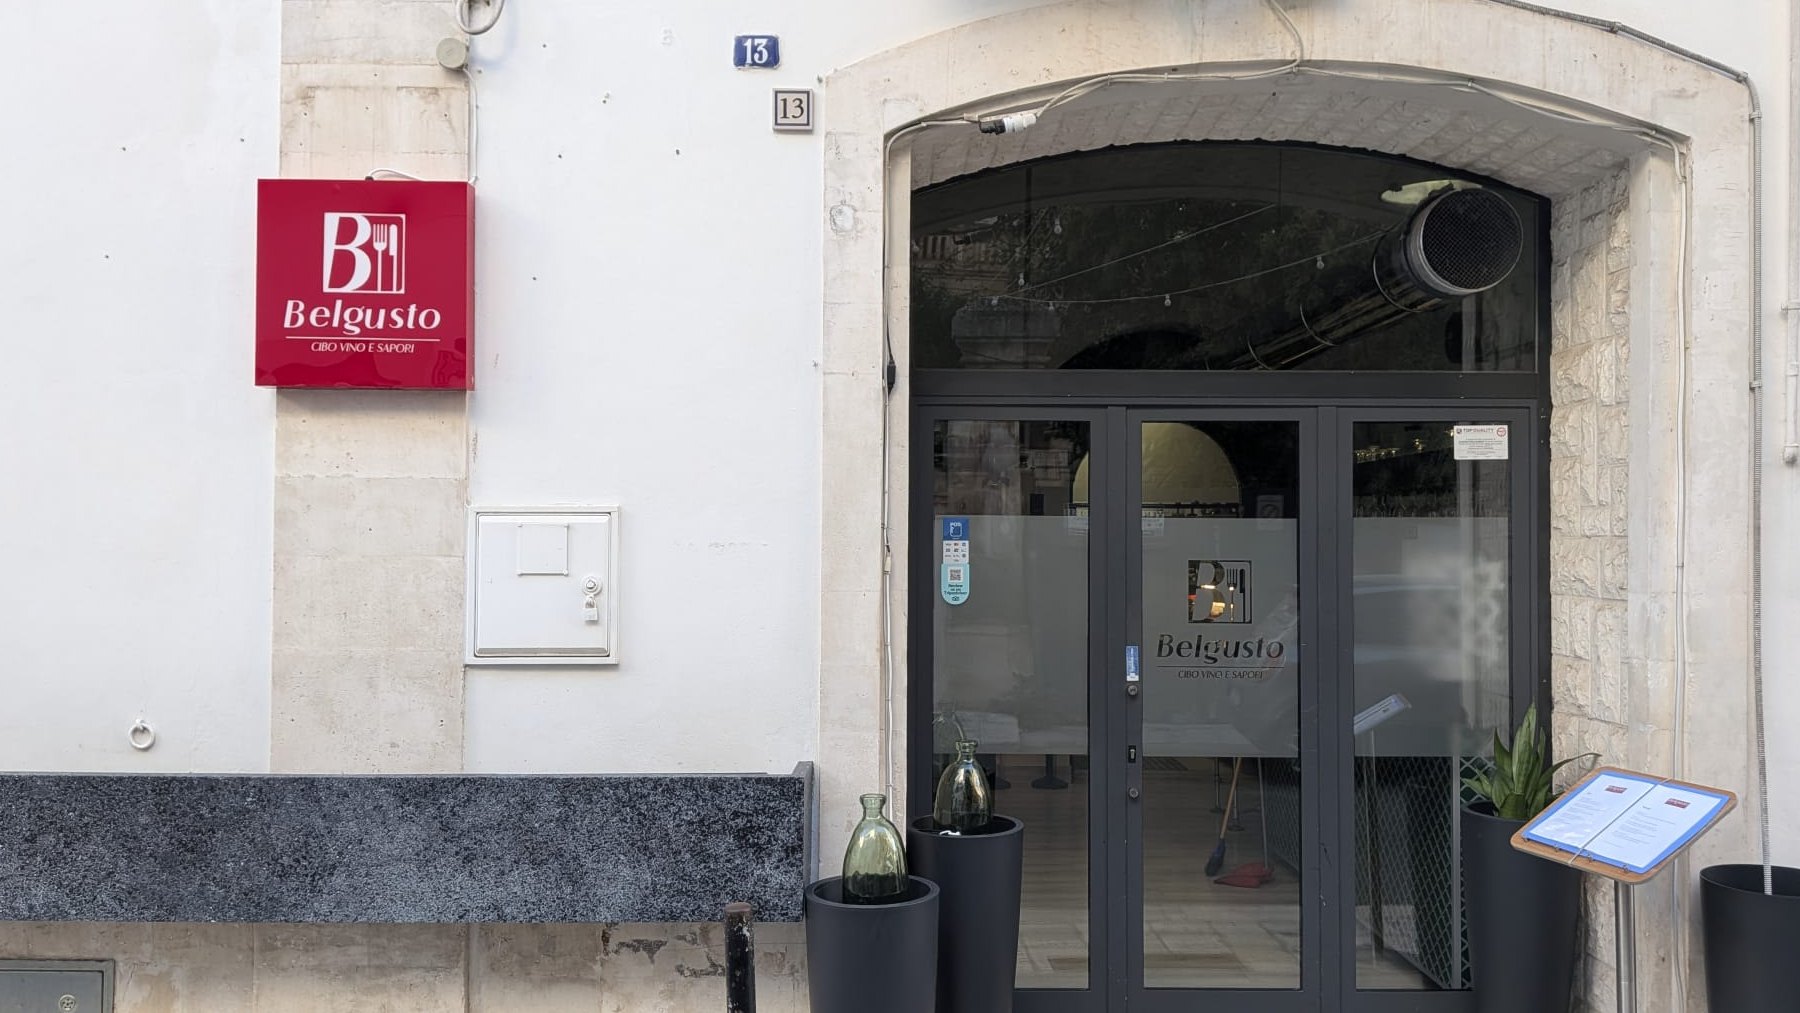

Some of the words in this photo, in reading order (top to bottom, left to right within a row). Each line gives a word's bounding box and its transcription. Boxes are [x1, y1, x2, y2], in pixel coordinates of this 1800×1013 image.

[743, 38, 768, 64] 13
[779, 97, 804, 119] 13
[283, 299, 441, 335] Belgusto
[311, 341, 337, 352] CIBO
[340, 342, 366, 353] VINO
[368, 343, 375, 353] E
[376, 343, 415, 353] SAPORI
[1156, 634, 1284, 665] Belgusto
[1178, 670, 1199, 679] CIBO
